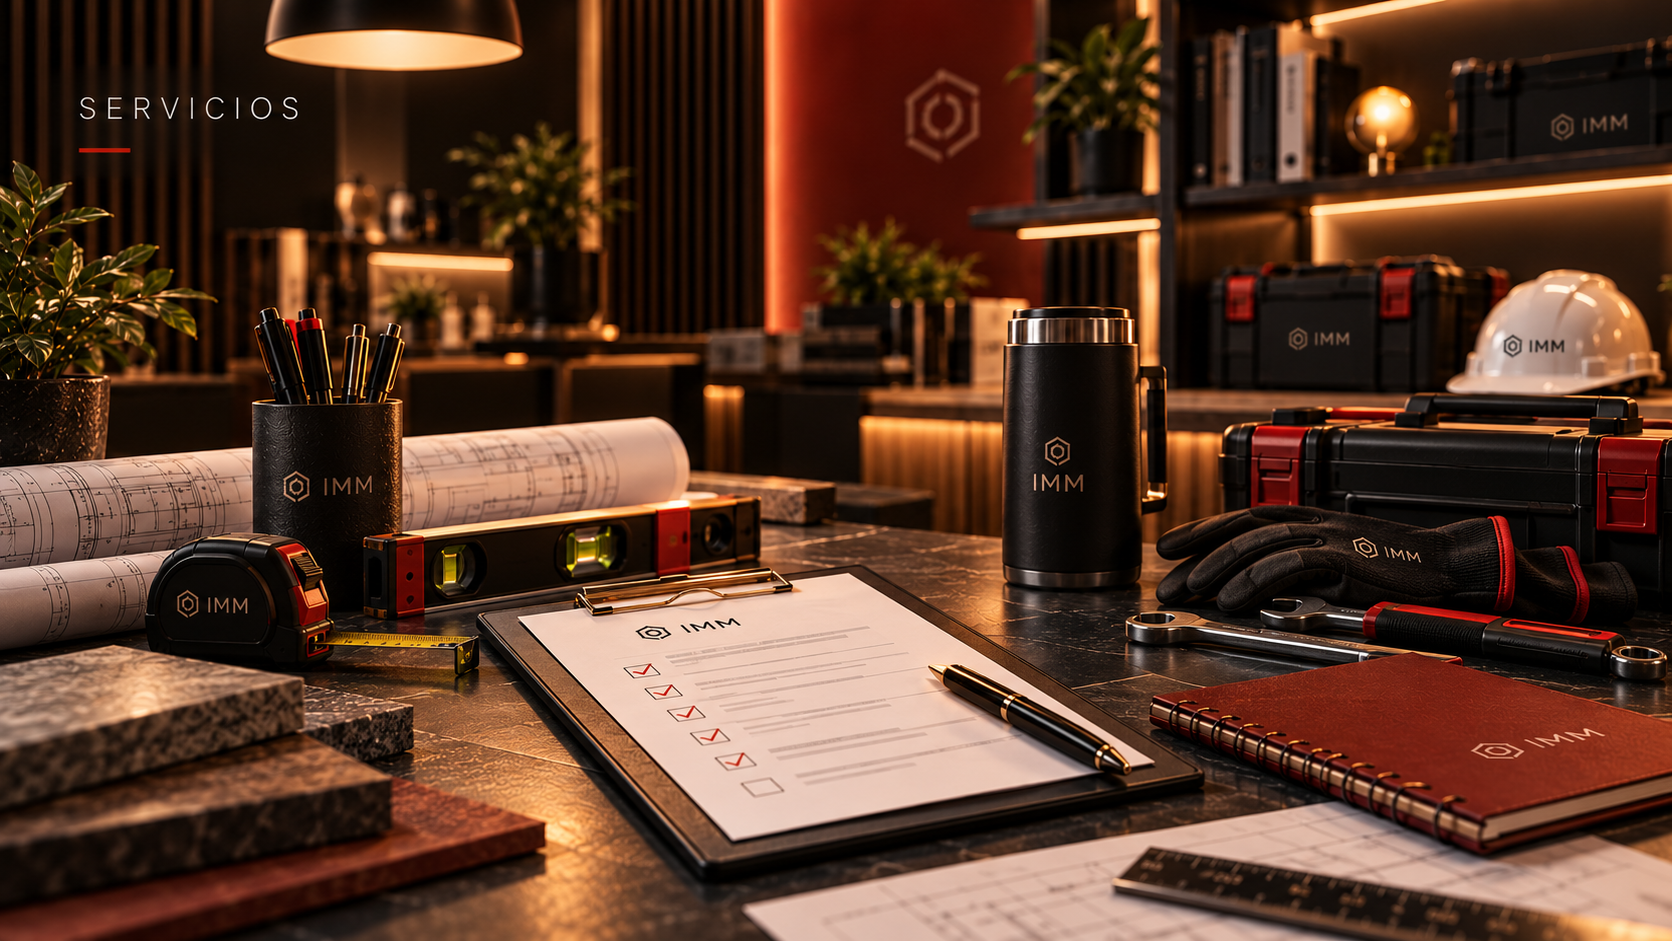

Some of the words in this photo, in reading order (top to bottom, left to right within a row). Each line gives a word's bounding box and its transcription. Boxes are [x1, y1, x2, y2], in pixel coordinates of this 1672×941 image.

[1583, 114, 1628, 134] IMM
[1314, 332, 1350, 346] IMM
[1529, 340, 1565, 353] IMM
[324, 475, 373, 496] IMM
[1033, 473, 1084, 492] IMM
[1384, 546, 1421, 563] IMM
[207, 597, 249, 614] IMM
[681, 618, 741, 633] IMM
[1524, 728, 1605, 748] IMM
